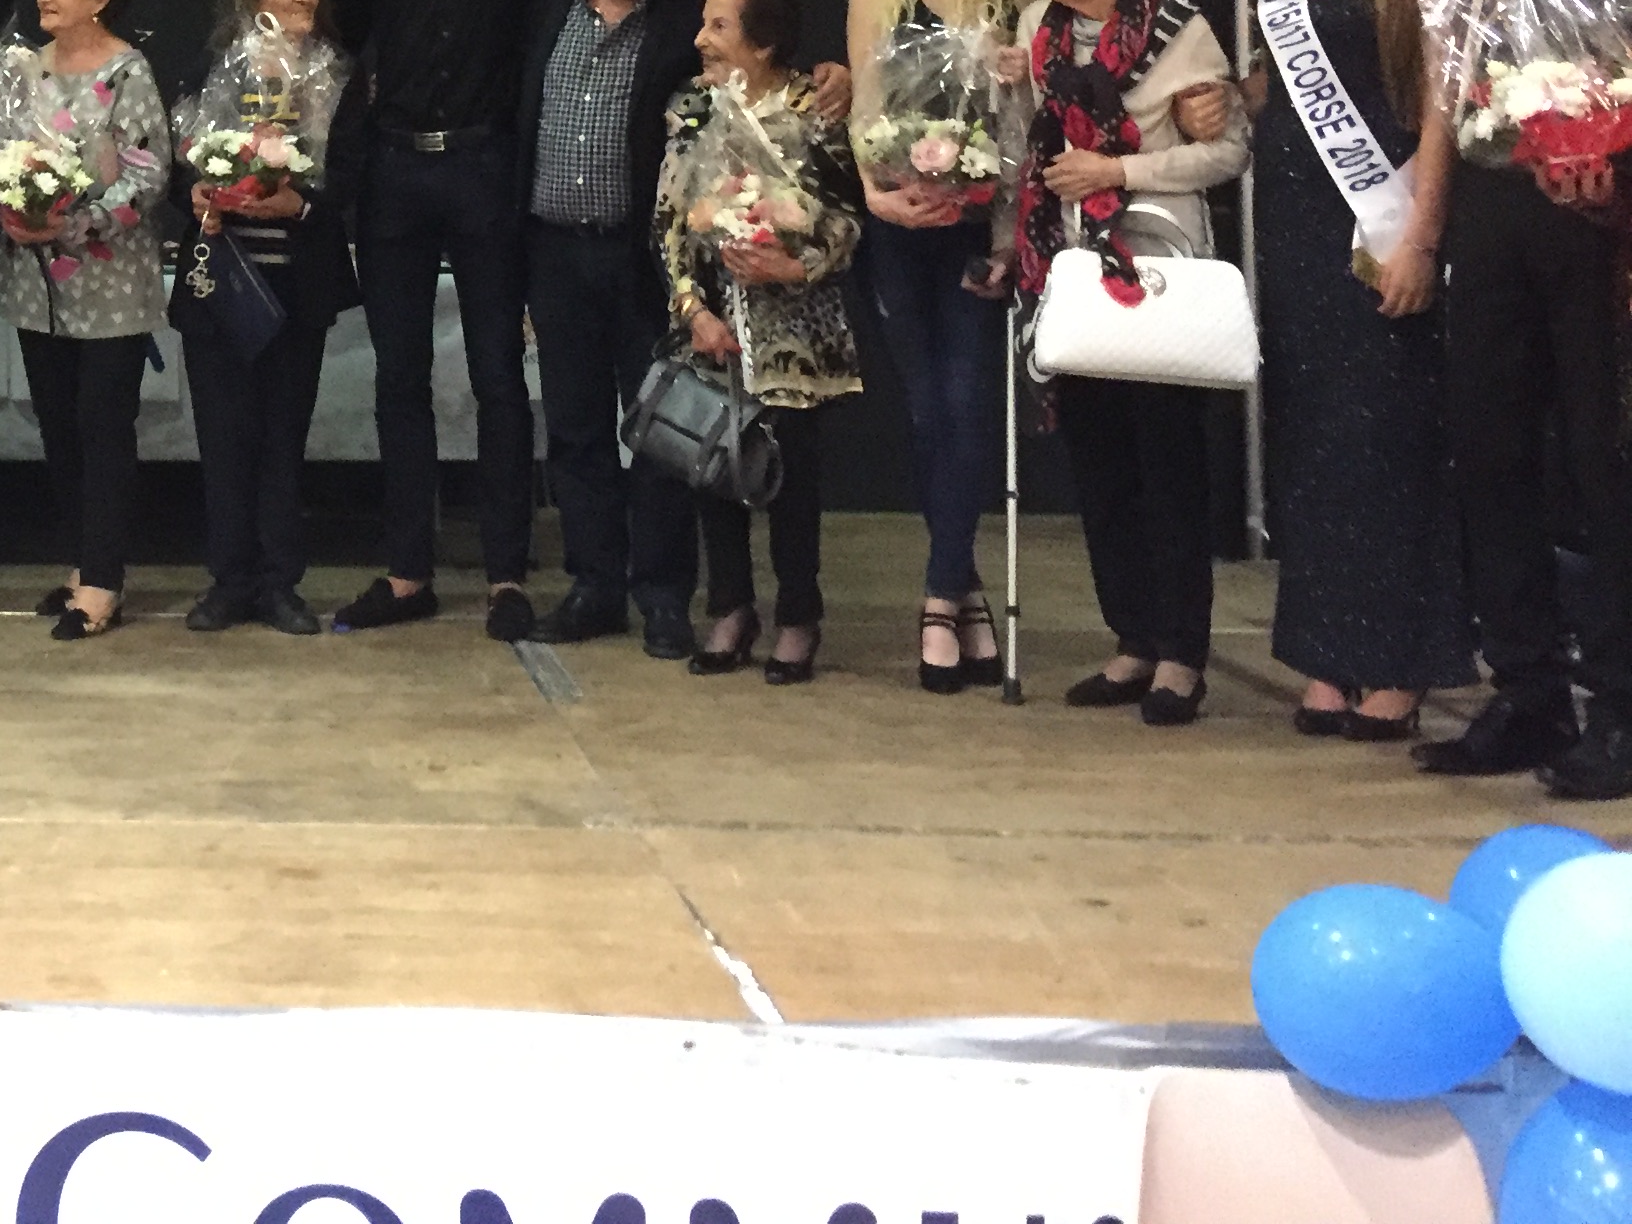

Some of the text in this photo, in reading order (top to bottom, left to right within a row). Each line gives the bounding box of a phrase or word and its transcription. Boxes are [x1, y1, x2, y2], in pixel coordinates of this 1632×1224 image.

[1265, 3, 1311, 49] 15/17
[1287, 49, 1357, 139] CORSE
[1327, 138, 1389, 192] 2018
